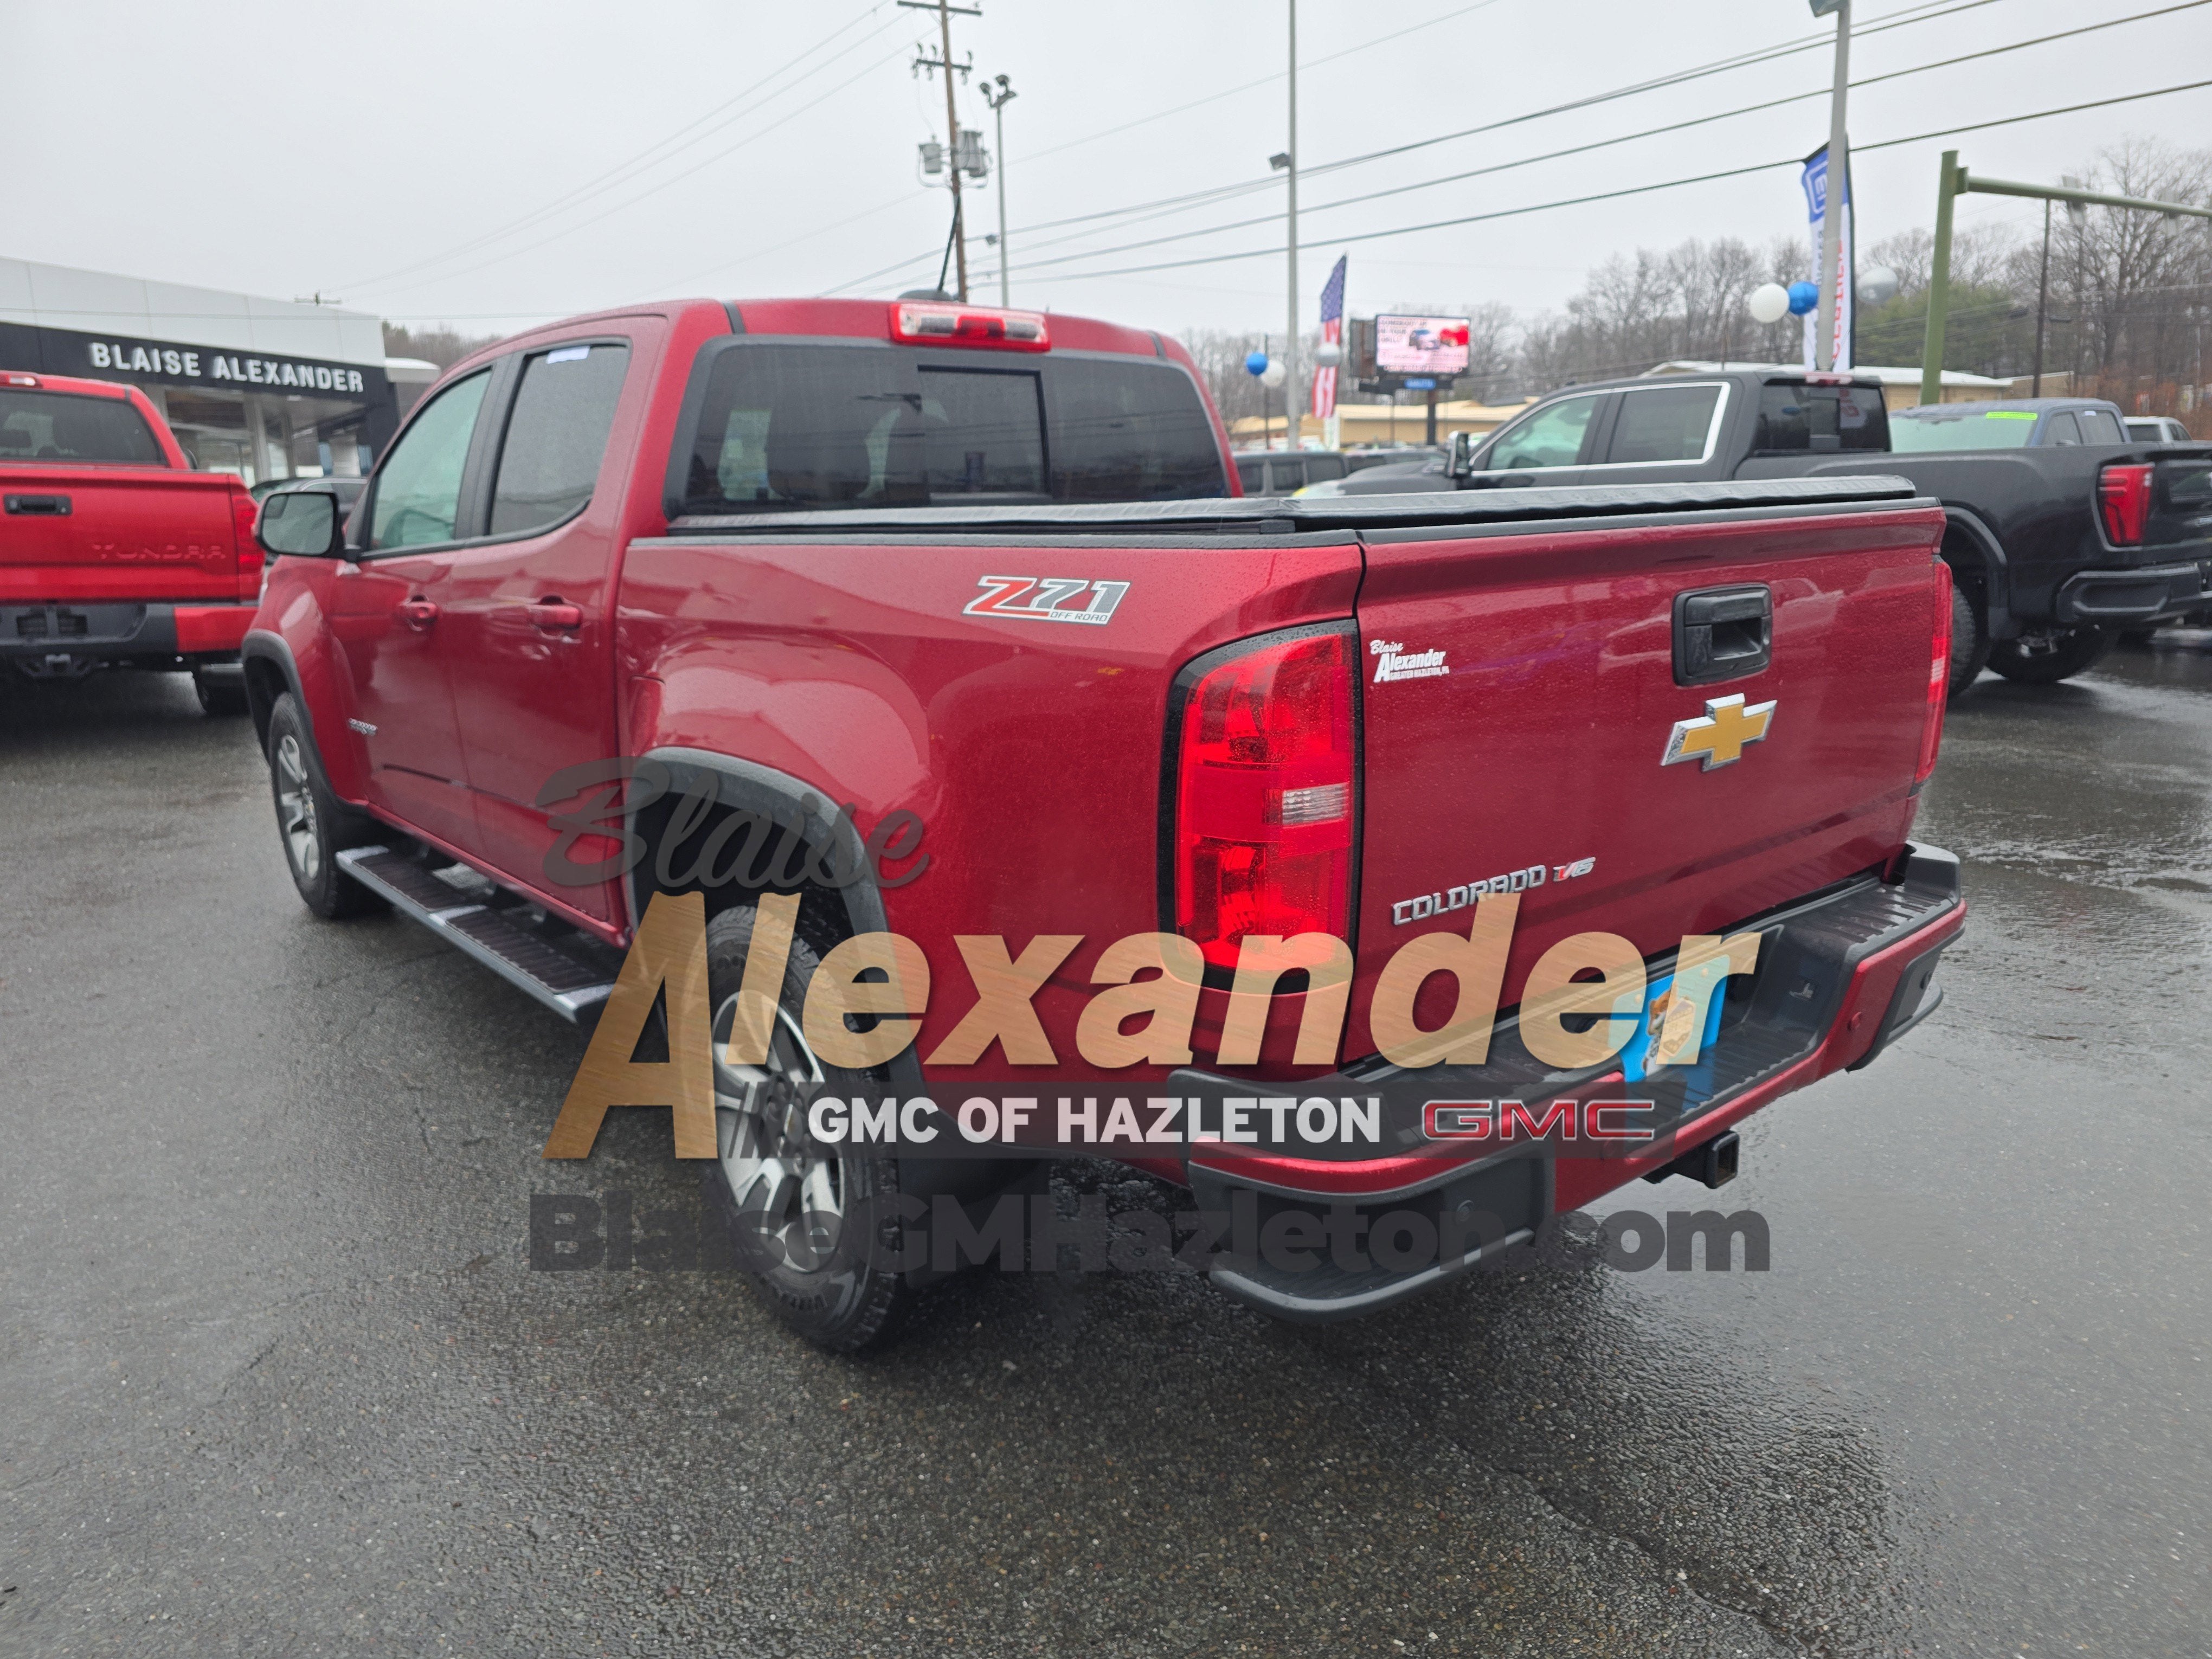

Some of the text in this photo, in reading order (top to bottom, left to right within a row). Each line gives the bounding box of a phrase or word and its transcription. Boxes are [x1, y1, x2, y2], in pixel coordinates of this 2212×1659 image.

[89, 342, 364, 393] BLAISE ALEXANDER
[91, 543, 226, 559] TUNDRA
[963, 575, 1131, 620] Z71
[1050, 612, 1108, 622] OFF ROAD
[1369, 639, 1404, 655] Blaise
[1373, 648, 1446, 683] Alexander
[1393, 857, 1596, 925] COLORADO V6
